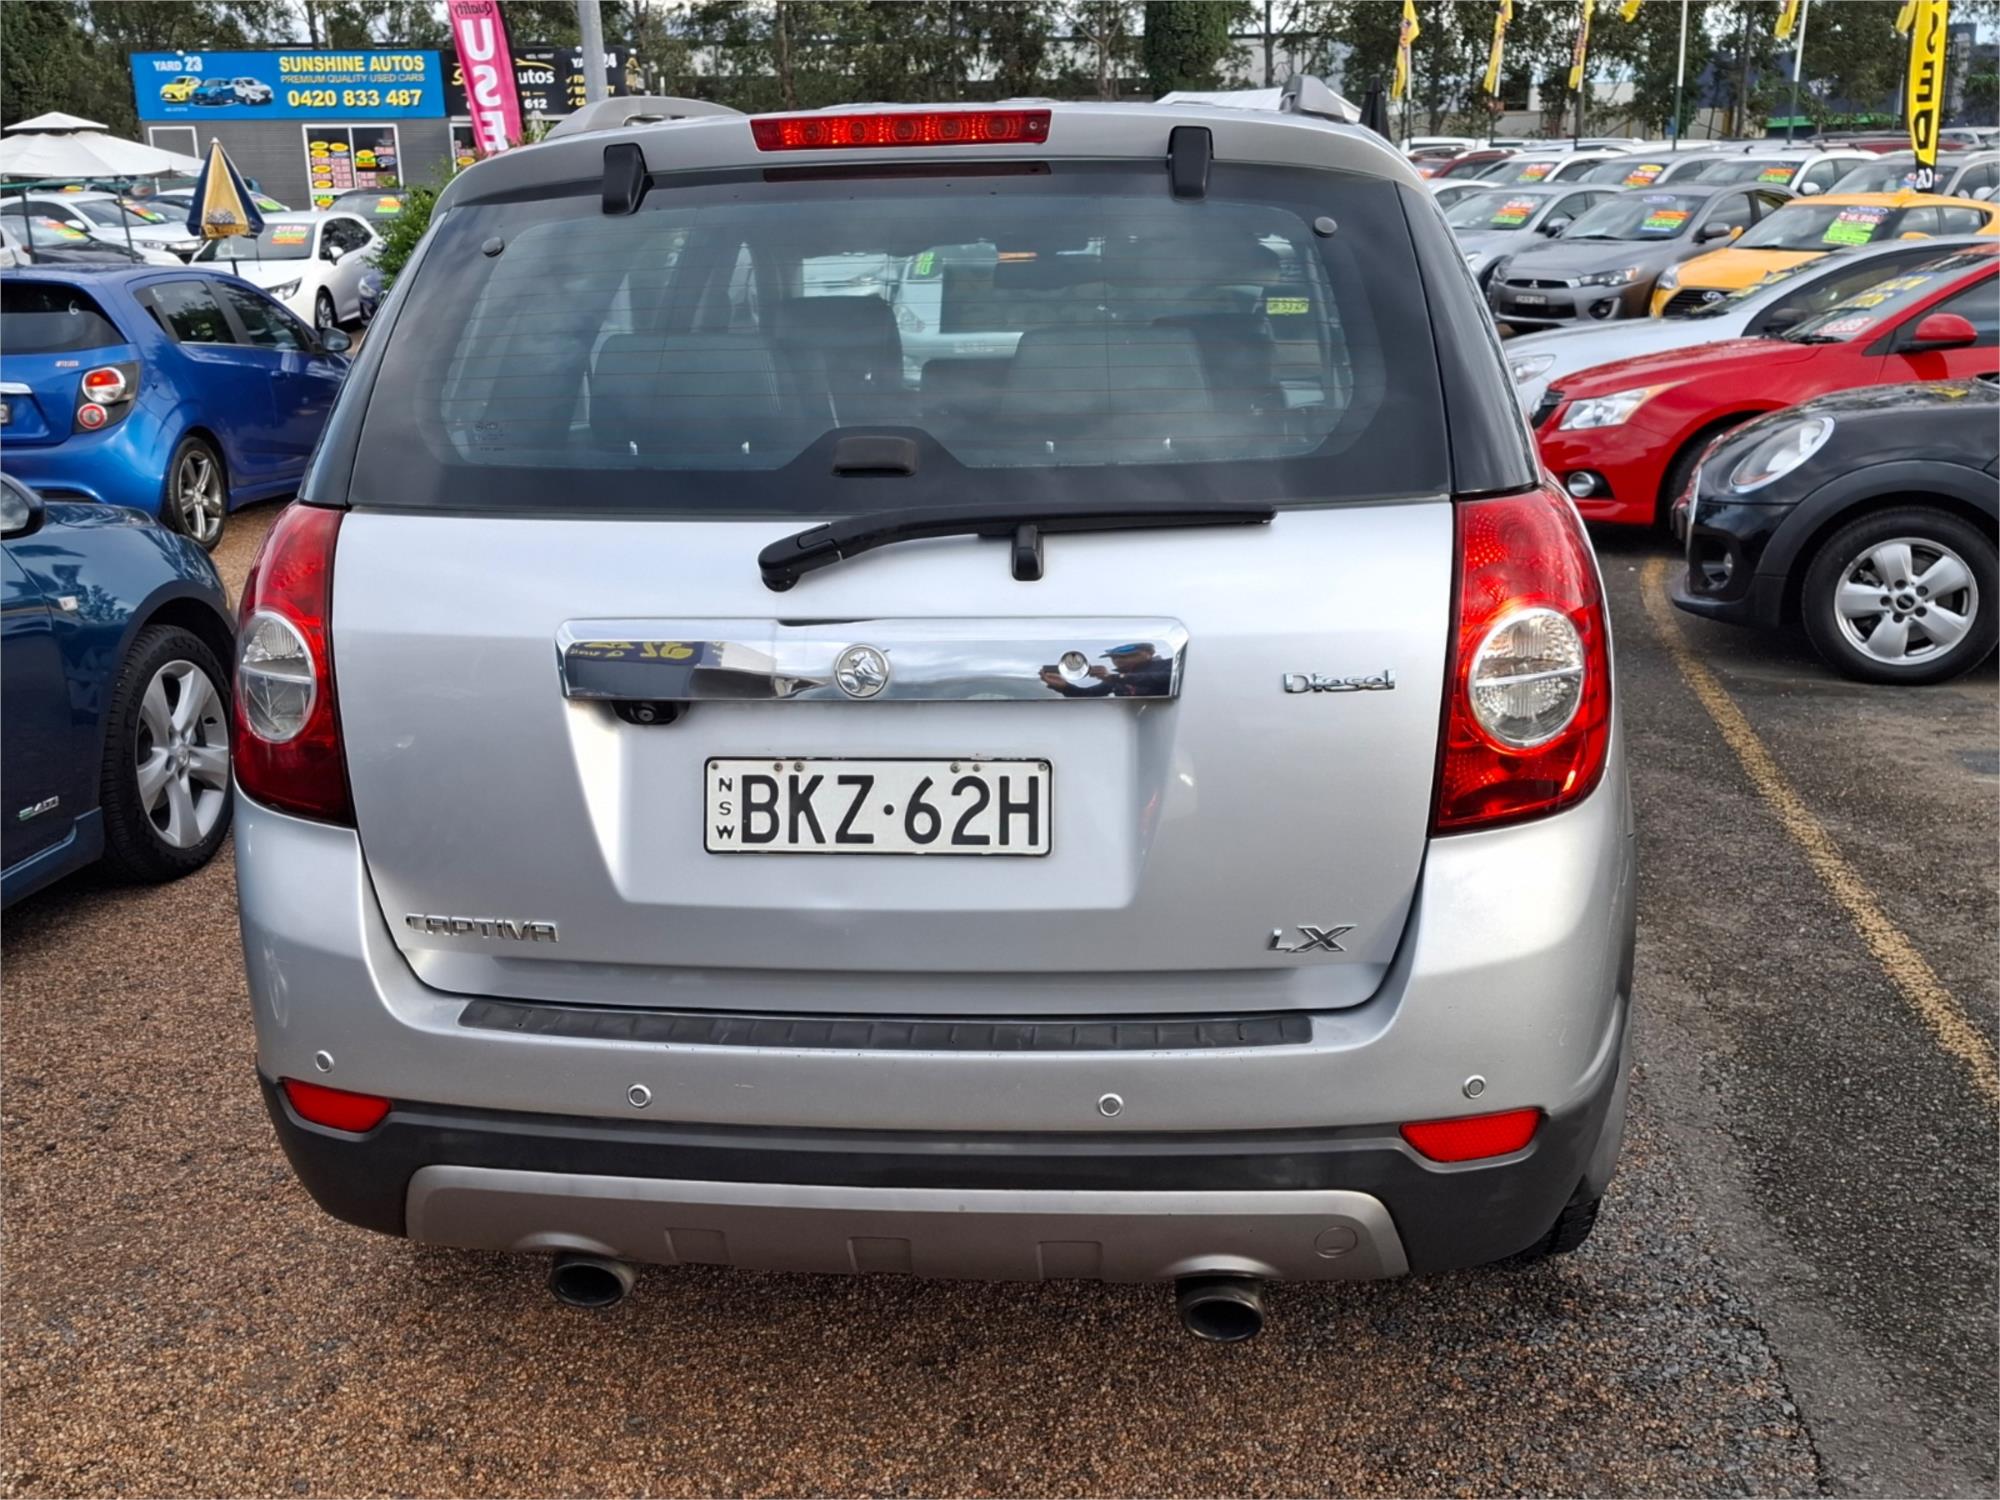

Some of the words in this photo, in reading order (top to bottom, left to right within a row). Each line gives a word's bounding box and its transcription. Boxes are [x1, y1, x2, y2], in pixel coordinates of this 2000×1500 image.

[153, 60, 182, 71] YARD
[184, 56, 203, 71] 23
[279, 56, 365, 72] SUNSHINE
[370, 55, 425, 71] AUTOS
[280, 75, 325, 83] PREMIUM
[327, 74, 367, 82] QUALITY
[369, 74, 396, 82] USED
[398, 74, 425, 82] CARS
[517, 69, 555, 84] utos
[287, 90, 337, 107] 0420
[343, 90, 380, 106] 833
[386, 89, 422, 106] 487
[524, 99, 548, 109] 612
[1283, 669, 1396, 694] Diesel
[405, 912, 560, 943] CAPTIVA
[1267, 923, 1358, 953] LX
